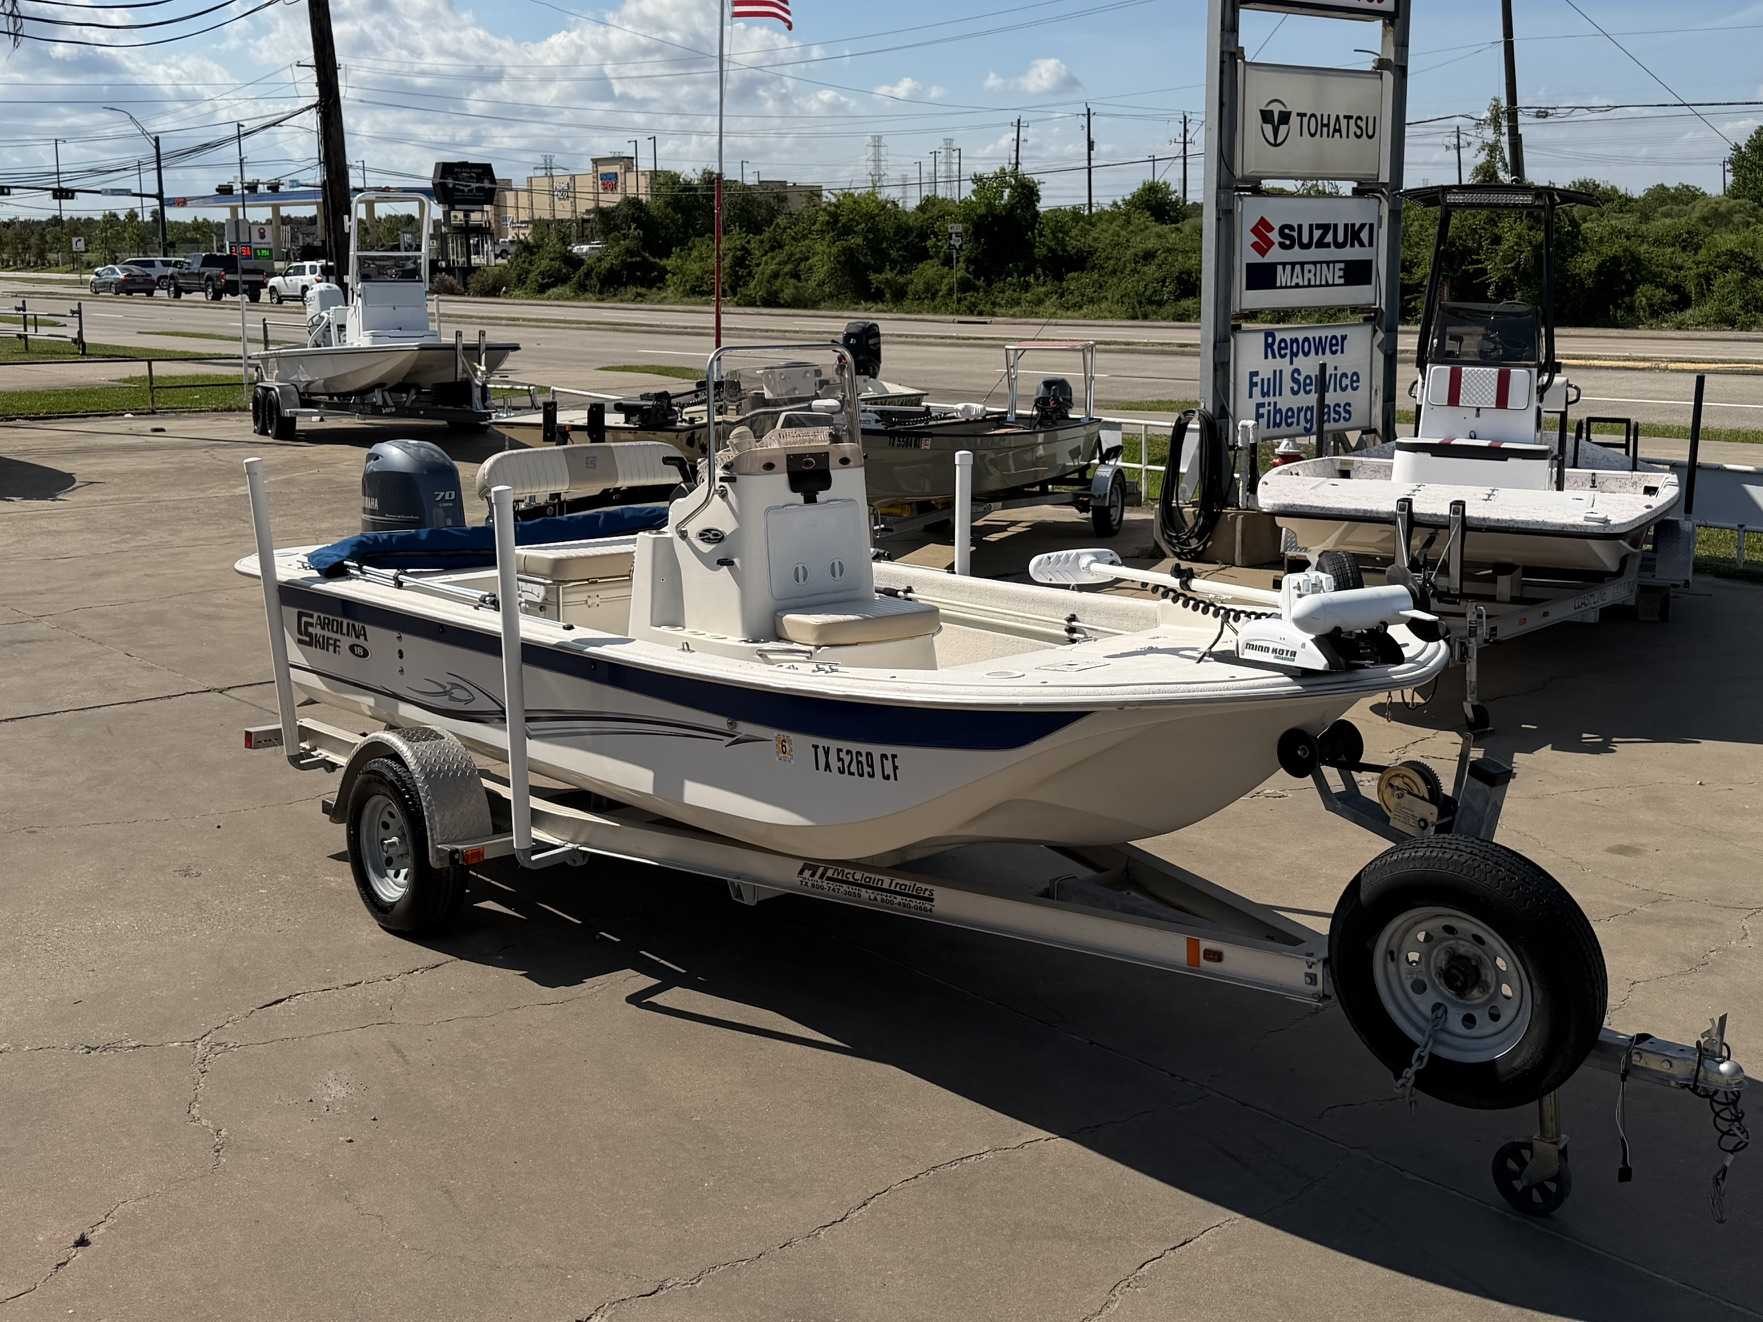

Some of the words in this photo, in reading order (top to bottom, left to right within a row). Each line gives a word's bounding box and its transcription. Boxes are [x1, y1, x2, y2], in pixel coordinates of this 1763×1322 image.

[1296, 112, 1376, 139] TOHATSU
[1278, 222, 1374, 250] SUZUKI
[1276, 262, 1345, 287] MARINE
[1264, 331, 1348, 365] Repower
[1248, 369, 1283, 399] Full
[1255, 401, 1353, 433] Fibergass
[433, 490, 456, 501] 70
[780, 739, 787, 754] 6
[812, 744, 832, 773] TX
[836, 747, 875, 778] 5269
[880, 753, 899, 781] CF
[831, 867, 884, 887] McClain
[888, 878, 935, 897] Trailers
